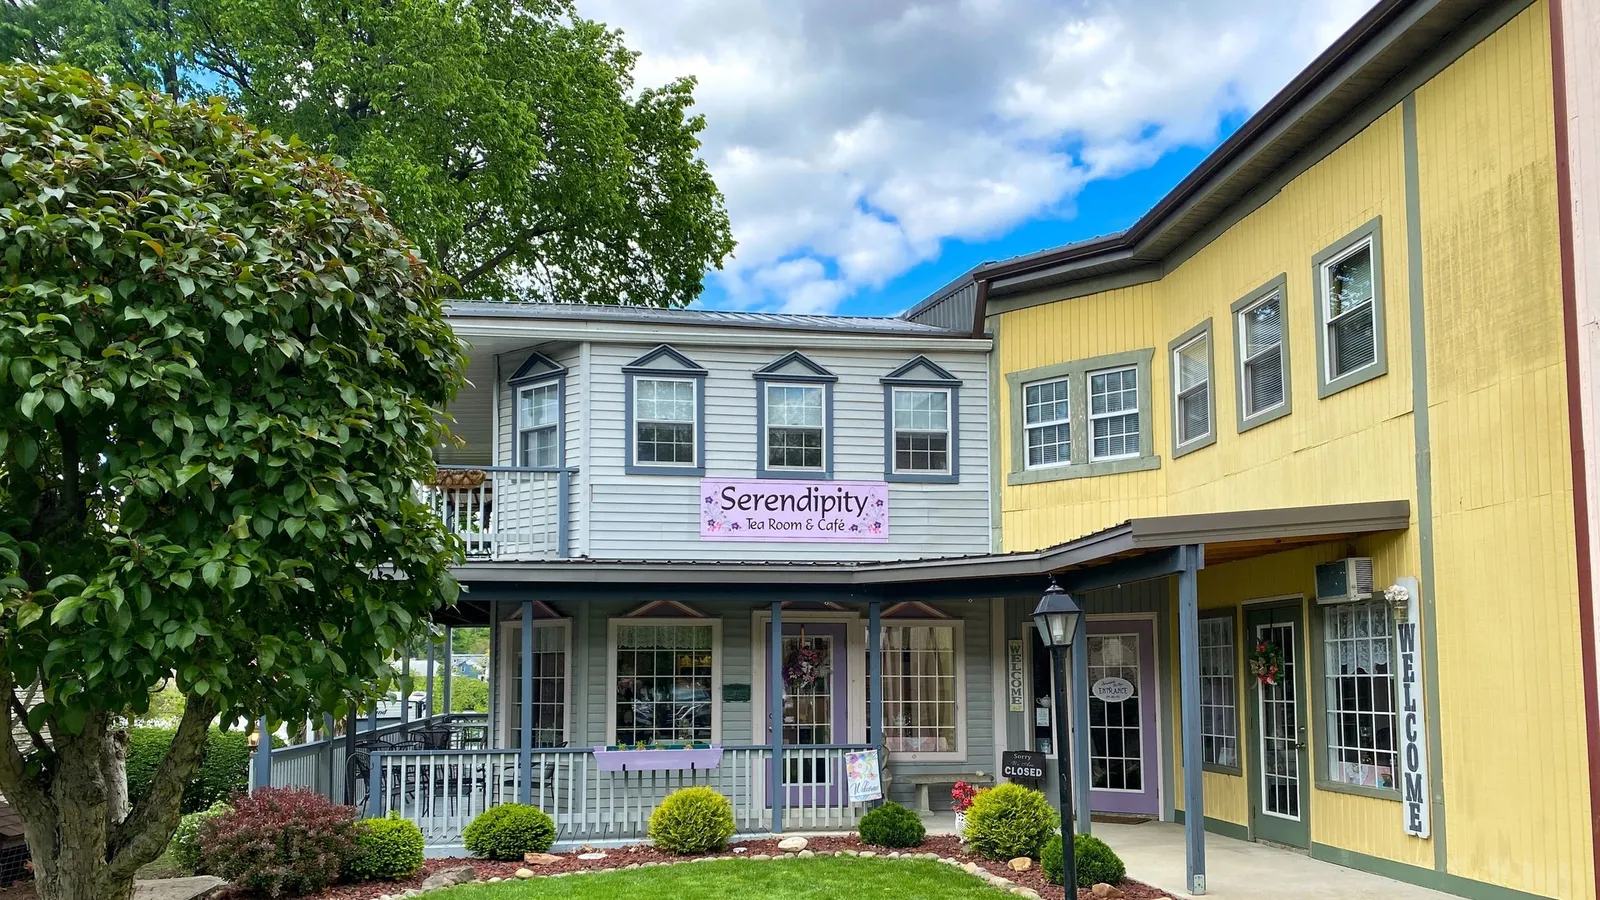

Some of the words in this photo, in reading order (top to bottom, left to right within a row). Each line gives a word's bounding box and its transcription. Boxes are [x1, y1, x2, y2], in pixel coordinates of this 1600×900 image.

[721, 486, 869, 517] Serendipity
[746, 518, 765, 530] Tea
[768, 518, 802, 531] Room
[805, 519, 814, 530] &
[817, 519, 845, 533] Café
[1010, 644, 1022, 705] WELCOME
[1398, 624, 1423, 832] WELCOME
[1013, 753, 1032, 761] Sorry
[1004, 766, 1043, 777] CLOSED
